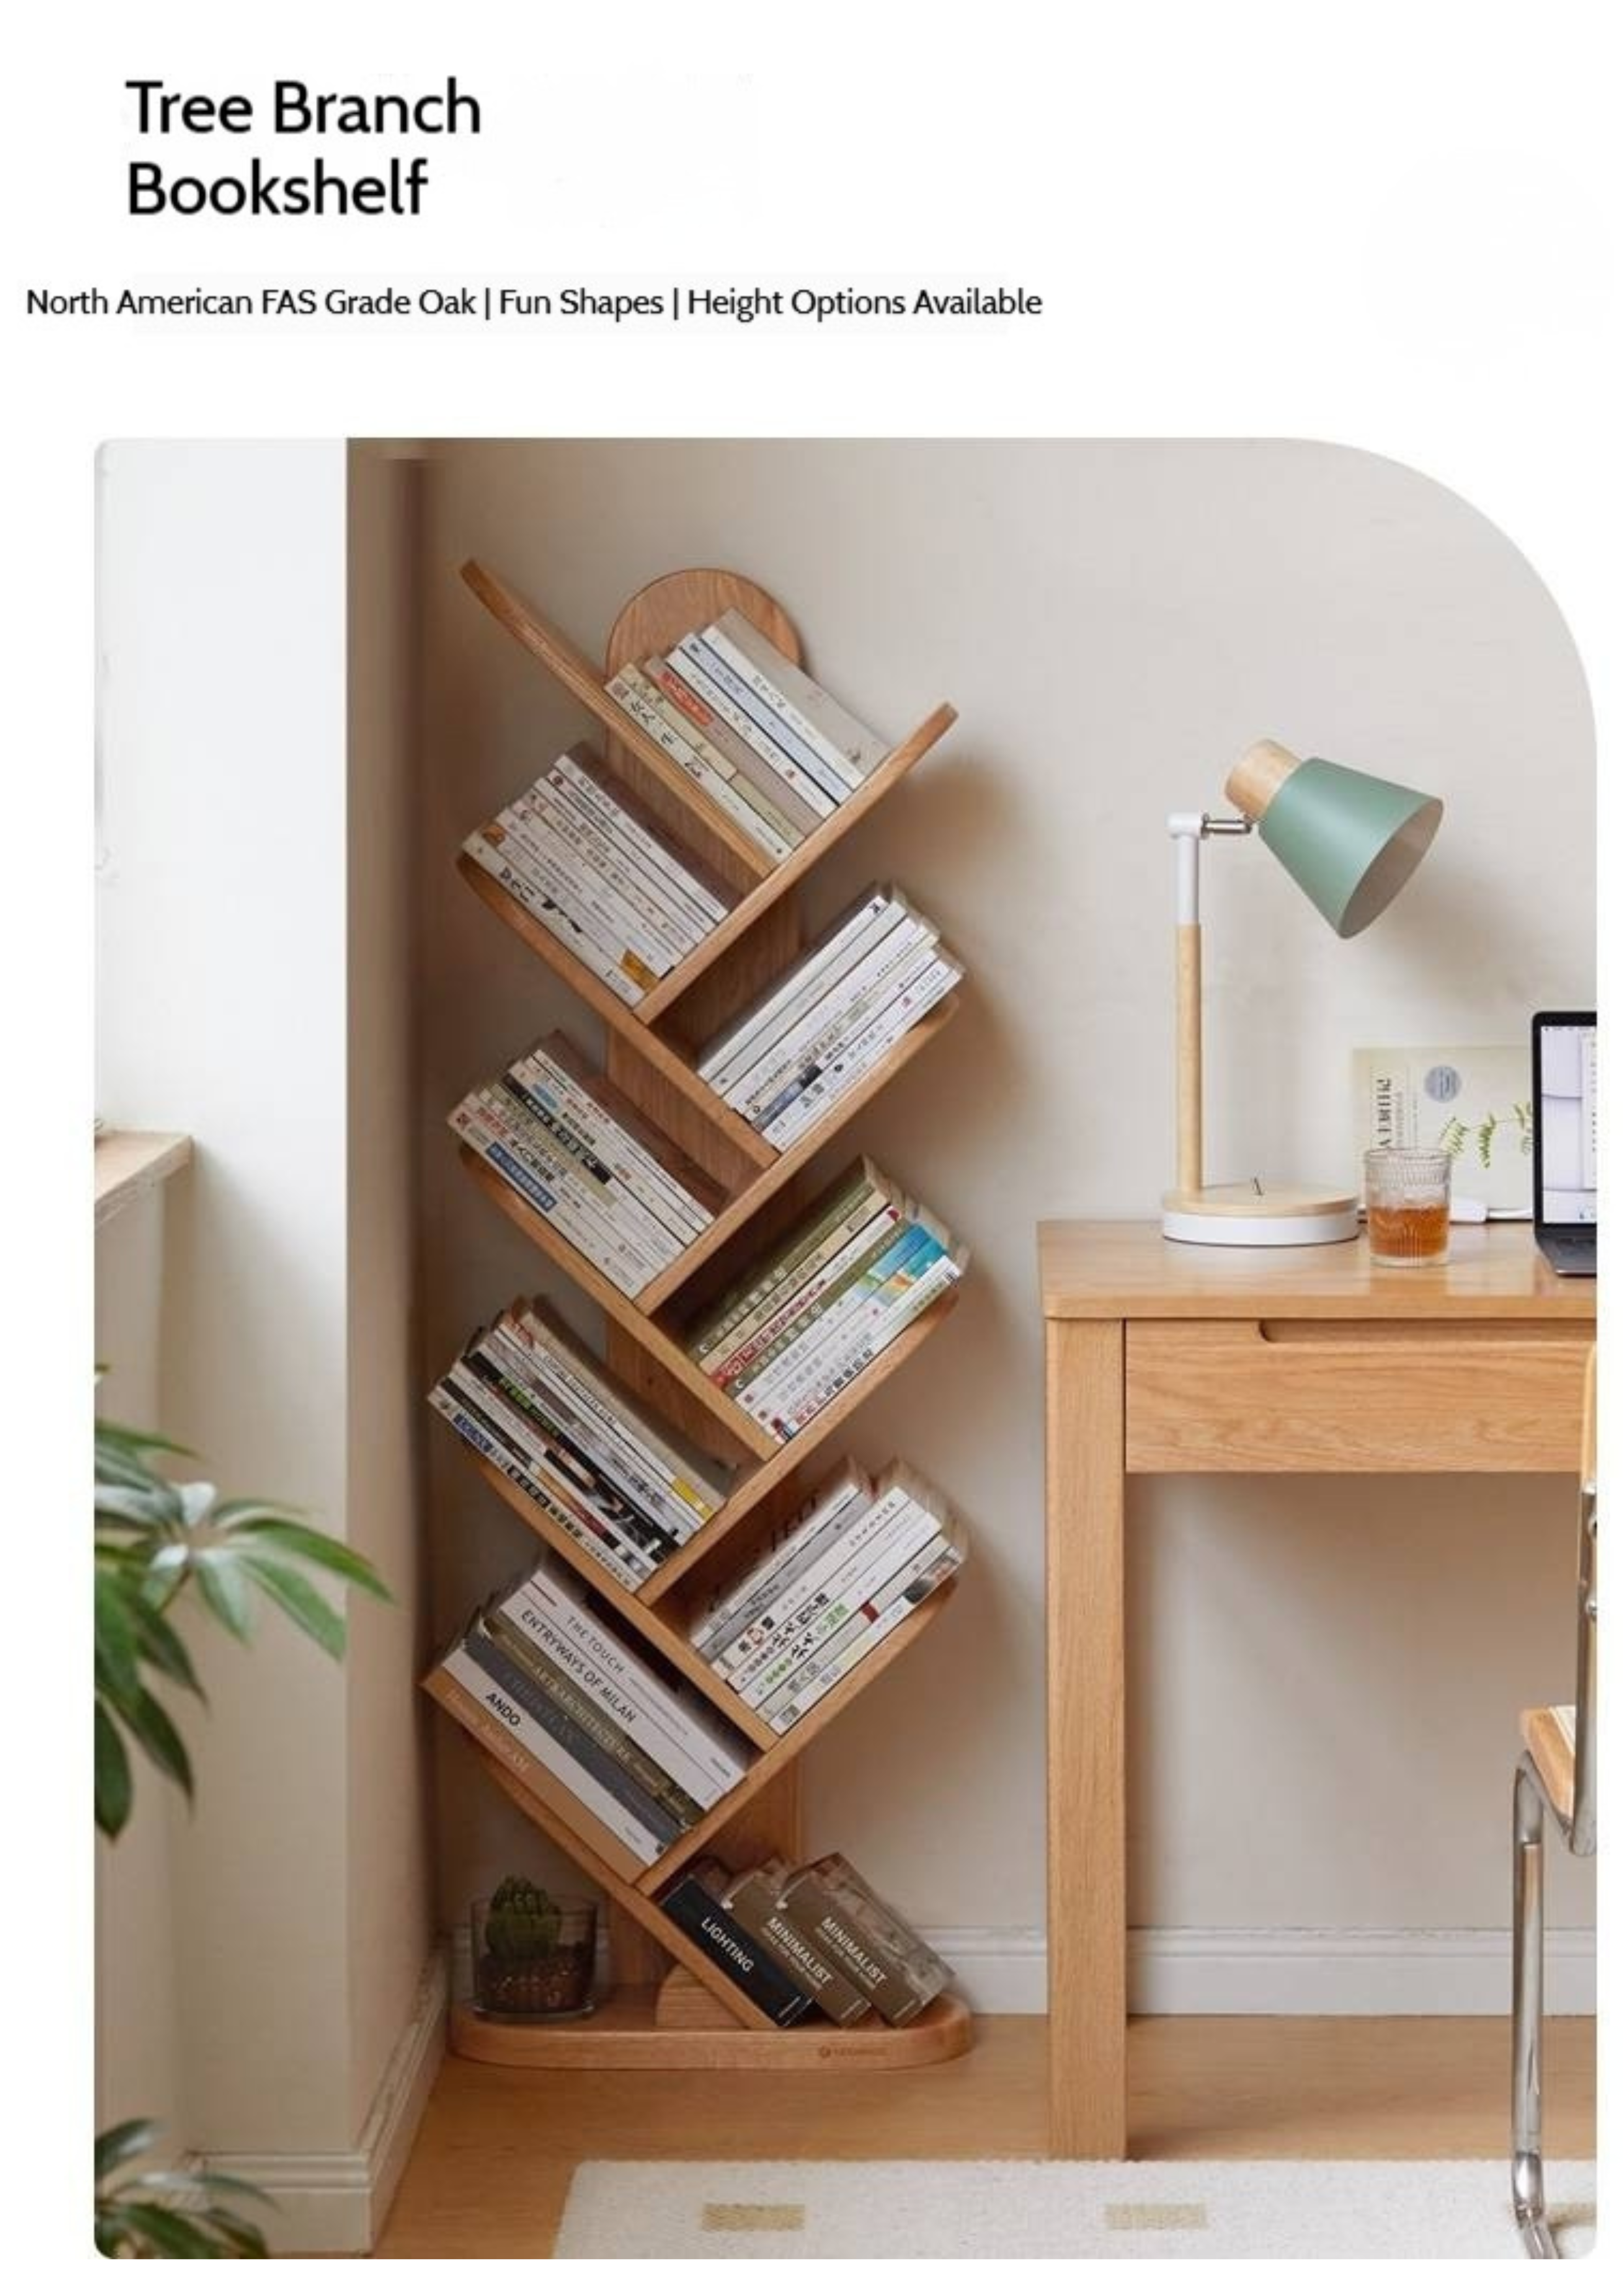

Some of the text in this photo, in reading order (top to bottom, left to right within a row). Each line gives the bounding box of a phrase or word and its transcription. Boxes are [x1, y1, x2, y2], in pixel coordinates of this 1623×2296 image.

[522, 1609, 586, 1674] ENTRYWAYS
[584, 1670, 603, 1687] OF
[599, 1687, 636, 1723] MILAN
[567, 1616, 625, 1674] THE TOUCH
[485, 1693, 521, 1726] ANDO
[701, 1916, 754, 1972] LIGHTING
[767, 1917, 833, 1984] MINIMALIST
[822, 1917, 887, 1984] MINIMALIST
